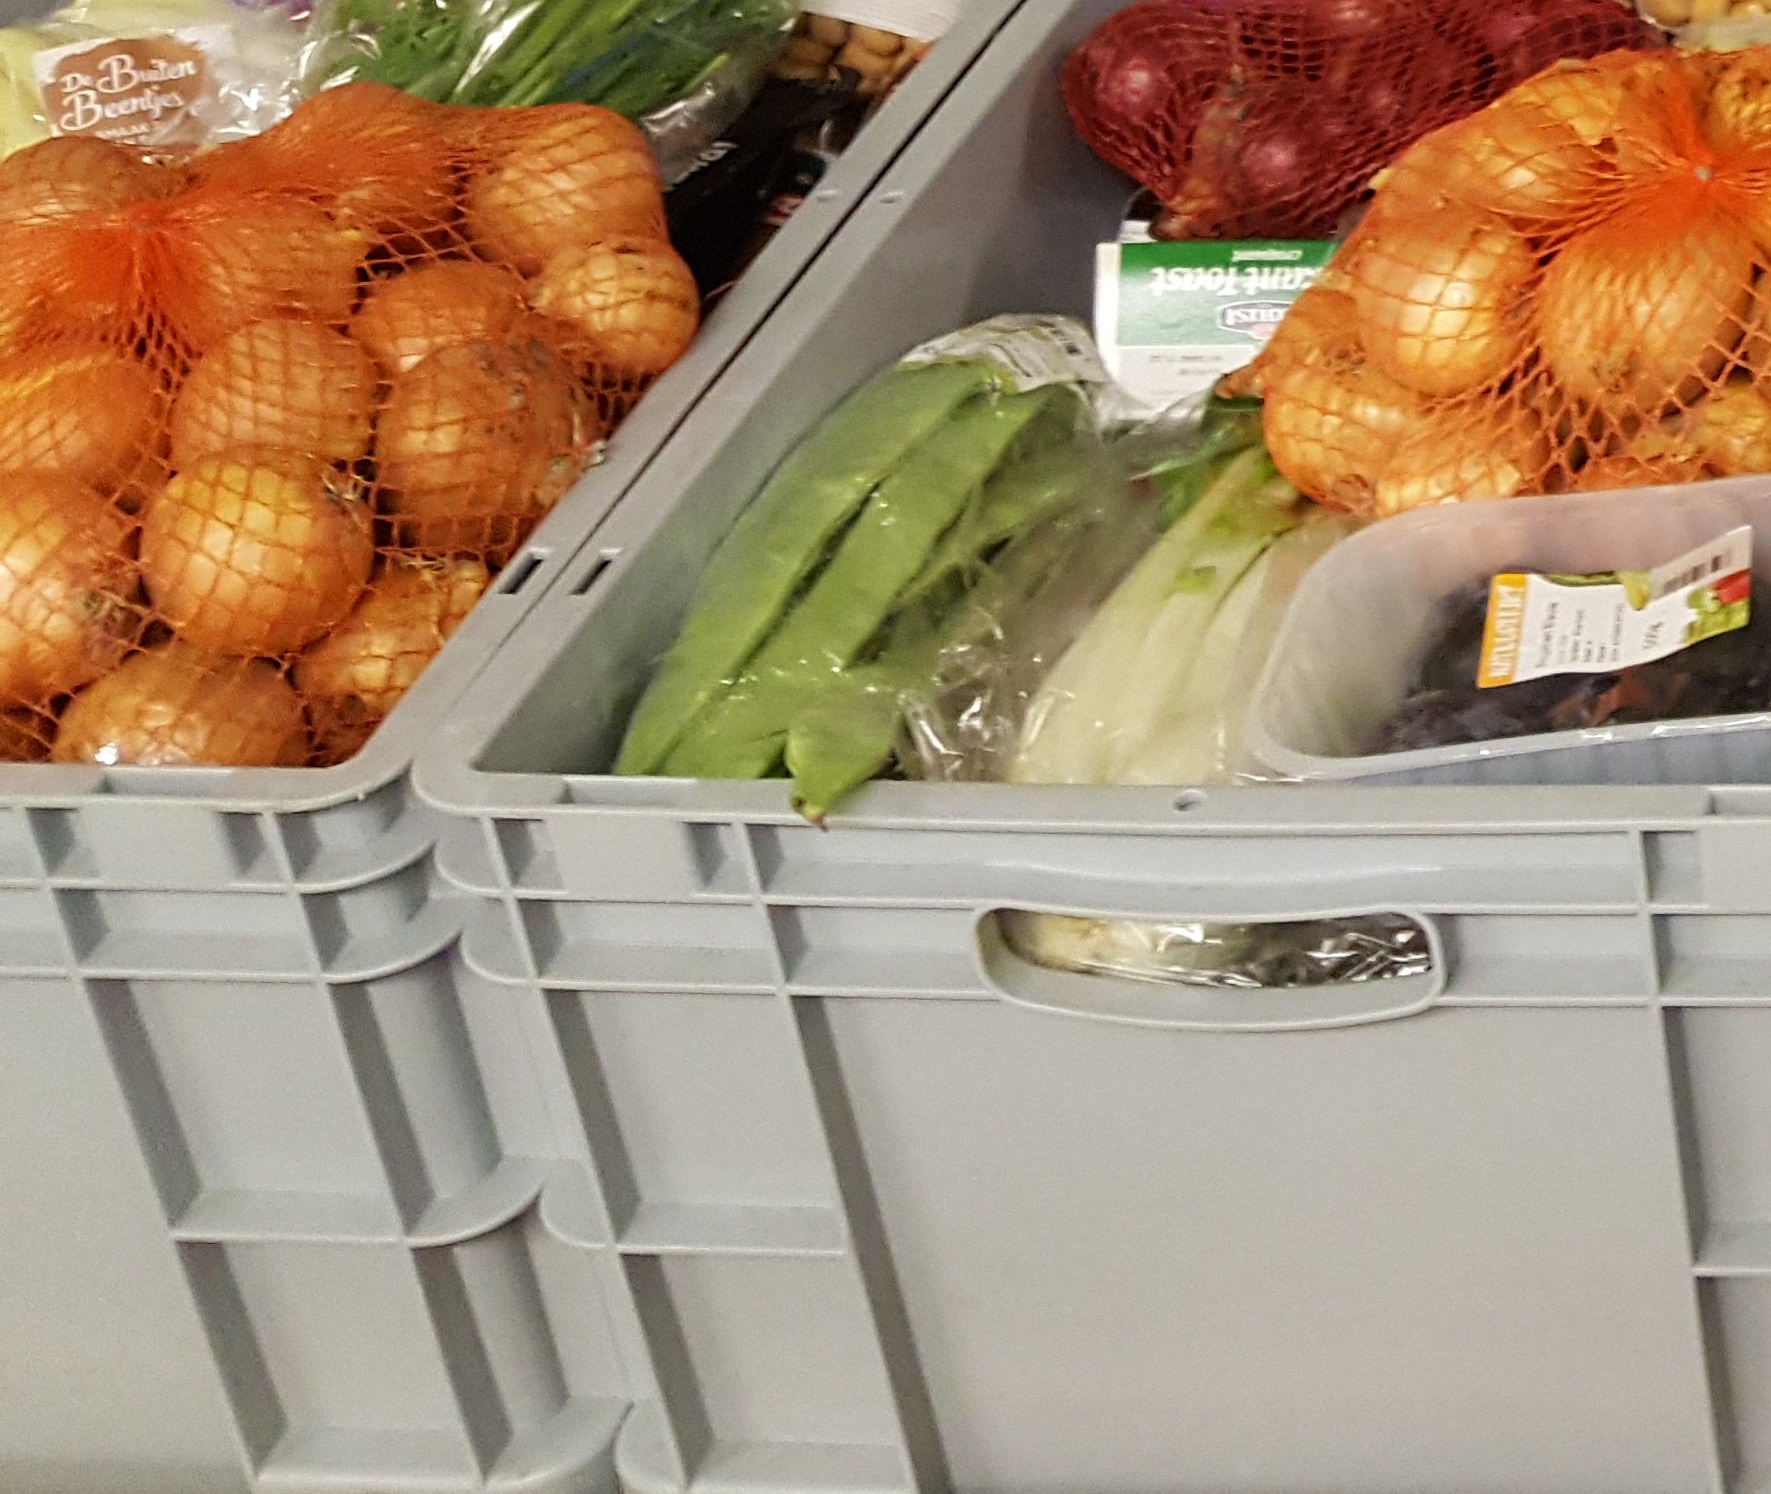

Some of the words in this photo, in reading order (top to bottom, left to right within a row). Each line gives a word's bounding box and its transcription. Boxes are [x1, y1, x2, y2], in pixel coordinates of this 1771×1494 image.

[95, 53, 198, 94] Buiten
[60, 86, 185, 132] Beentjes
[1149, 265, 1240, 297] Toast
